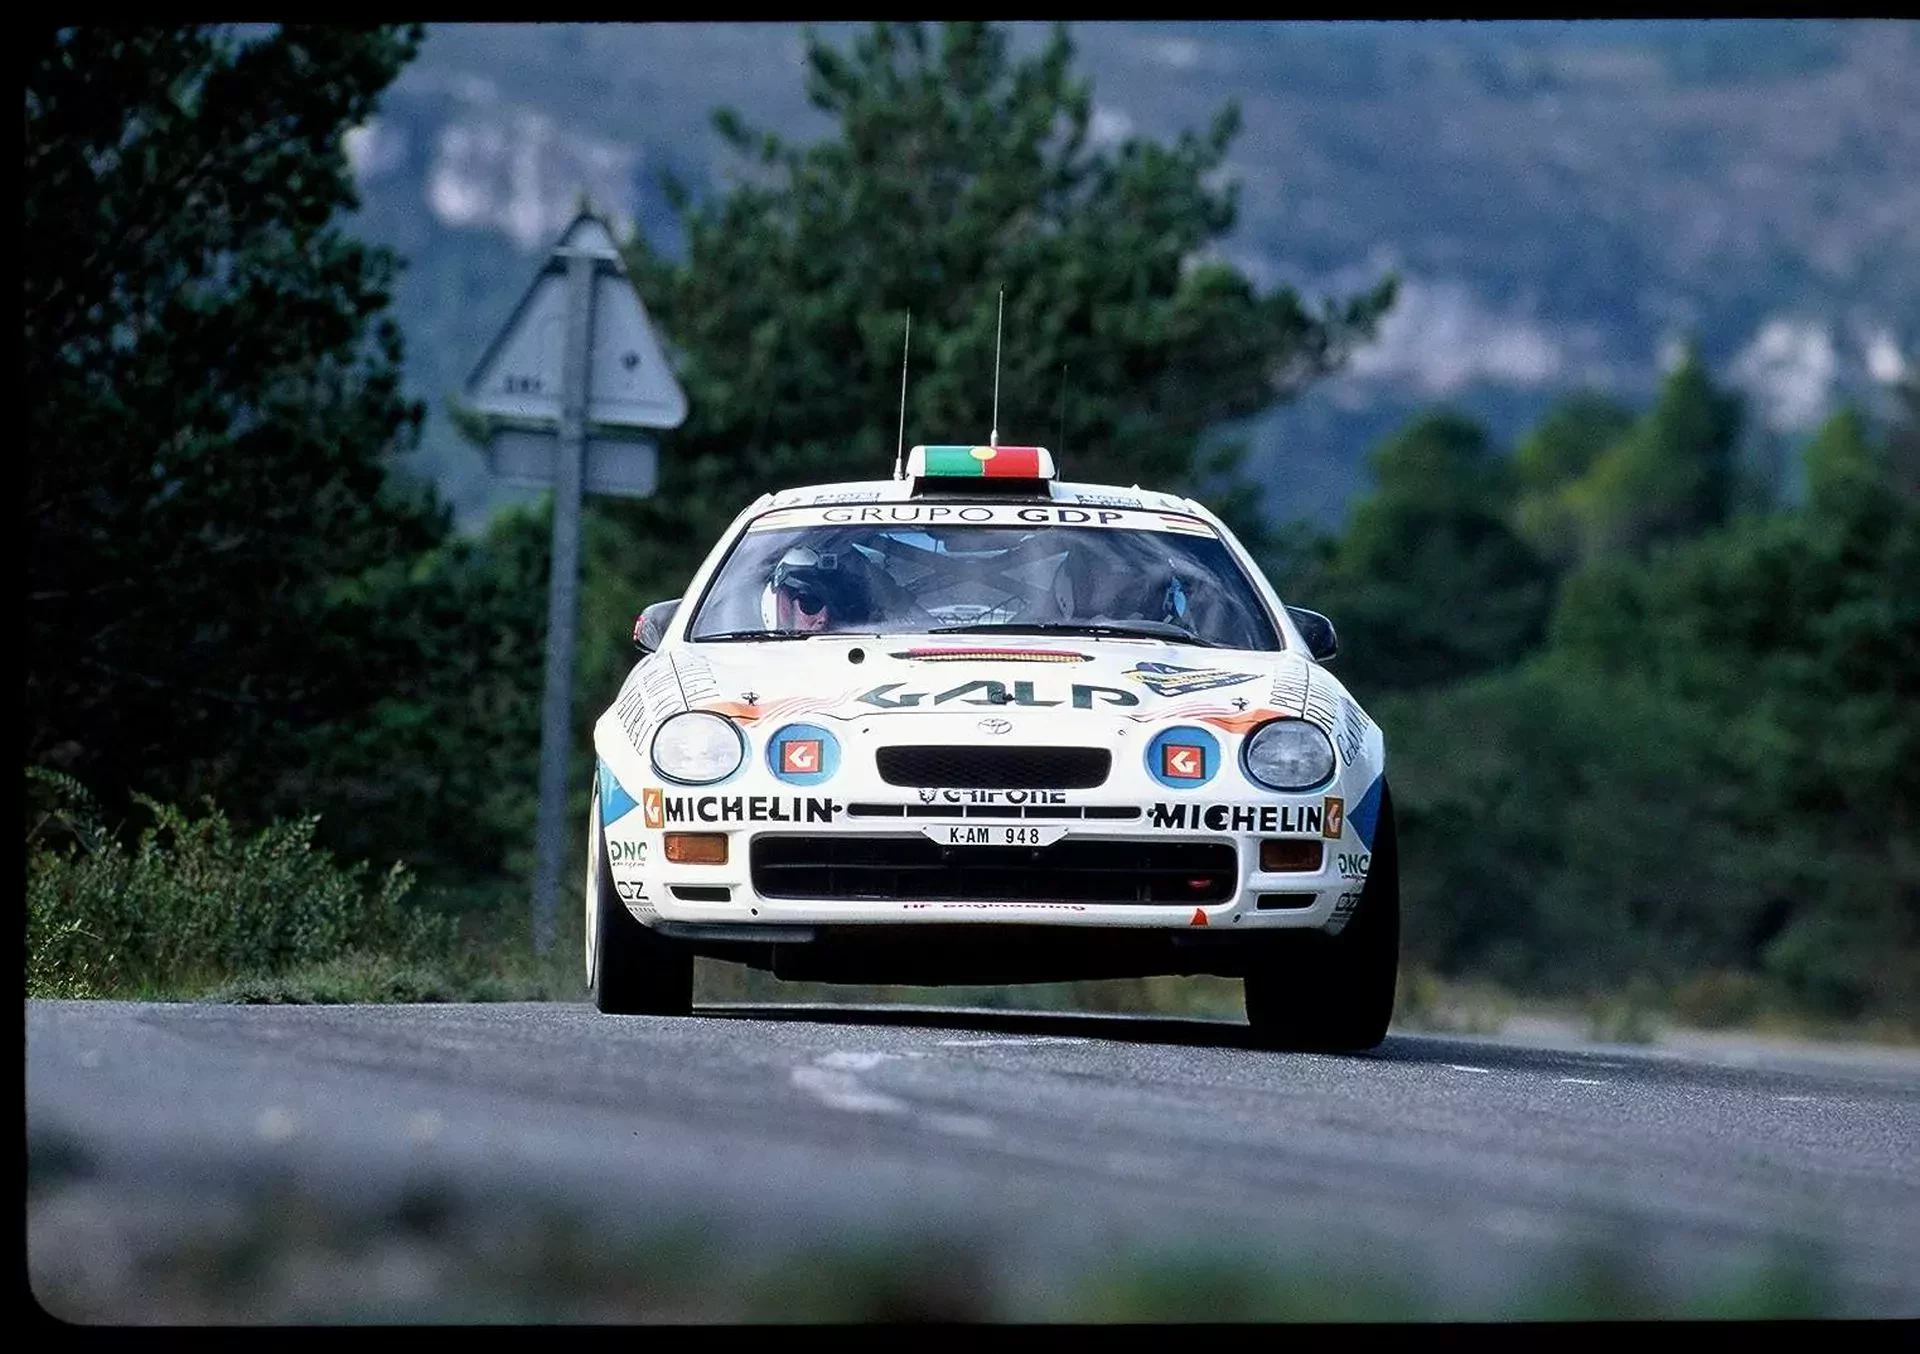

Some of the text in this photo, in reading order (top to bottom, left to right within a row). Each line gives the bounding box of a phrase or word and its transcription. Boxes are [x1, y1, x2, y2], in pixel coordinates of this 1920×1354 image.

[822, 507, 1124, 525] GRUPO GDP
[855, 680, 1140, 710] GALP
[665, 796, 833, 823] MICHELIN
[1153, 803, 1322, 832] MICHELIN
[950, 828, 1040, 844] K-AM 948
